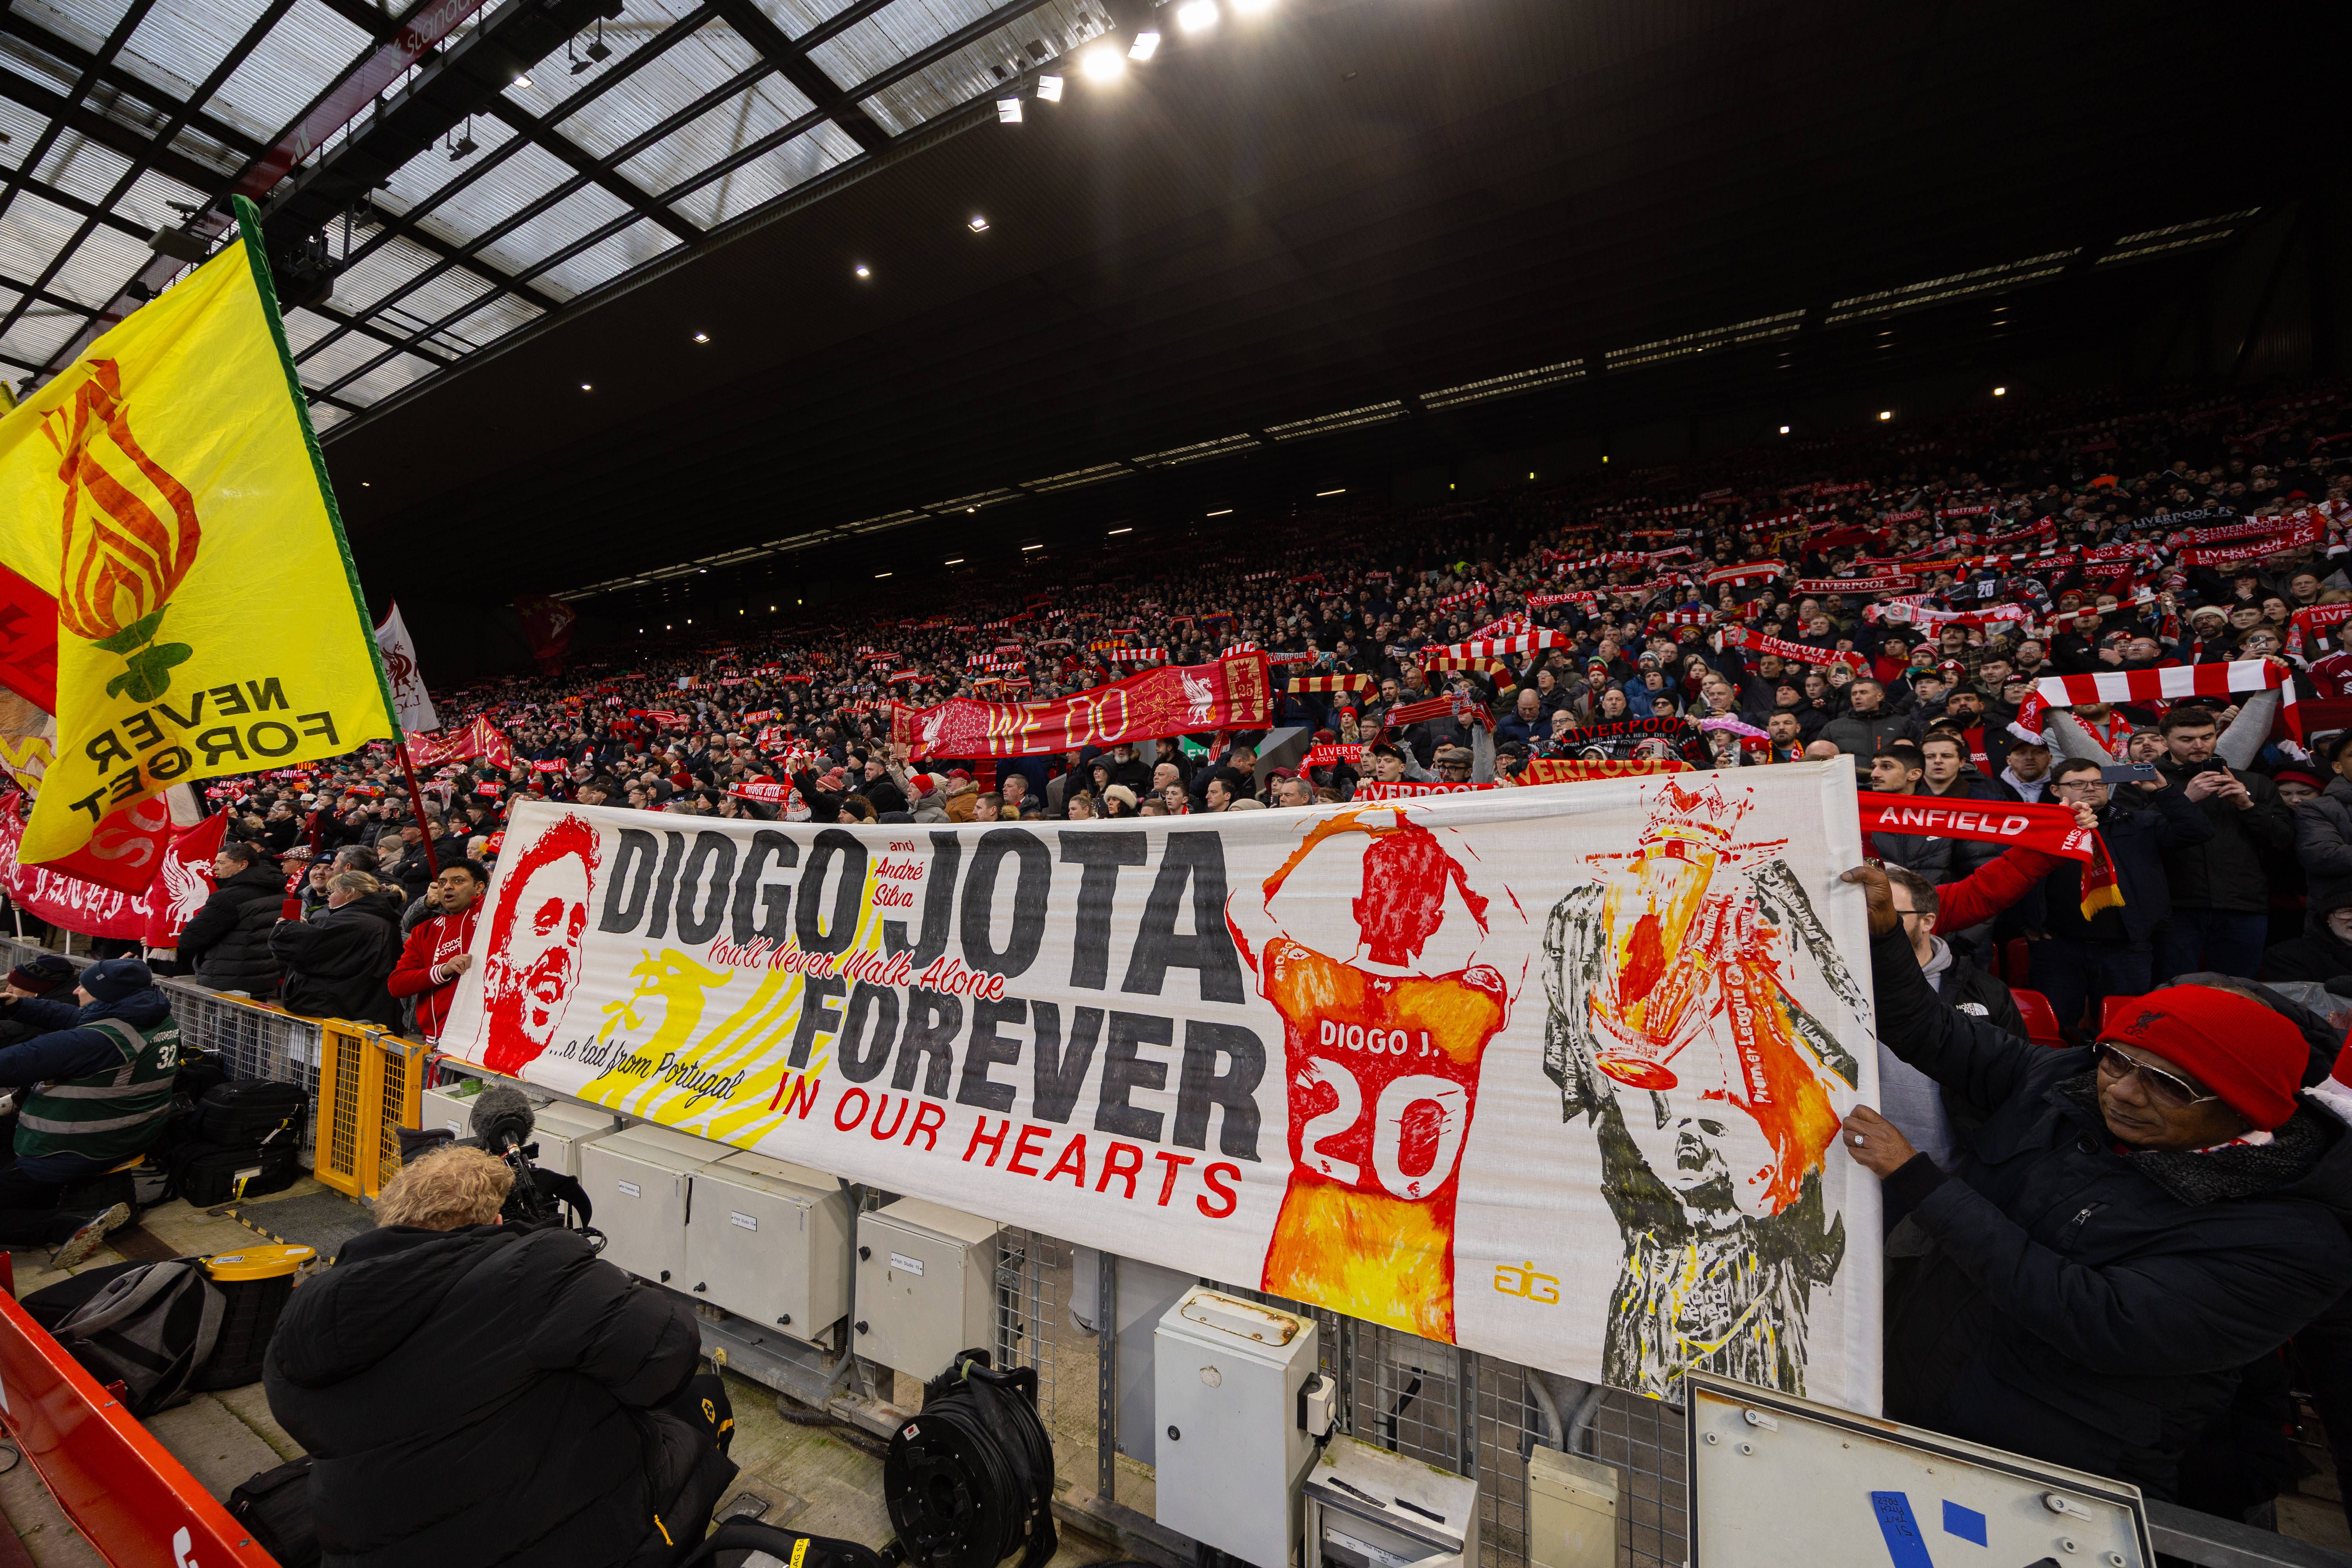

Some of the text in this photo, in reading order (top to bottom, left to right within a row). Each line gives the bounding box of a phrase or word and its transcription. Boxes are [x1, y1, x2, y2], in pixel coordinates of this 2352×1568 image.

[2132, 508, 2211, 528] LIVERPOOL
[2211, 520, 2275, 537] LIVERPOOL
[2196, 526, 2314, 560] LIVERPOOL FC
[2198, 536, 2315, 565] YOU'LL NEVER WALK ALONE
[1811, 580, 1888, 591] LIVERPOOL
[1977, 584, 1994, 599] 20
[1529, 593, 1579, 603] LIVERPOOL
[2307, 603, 2350, 612] HAMPIONS
[1270, 652, 1308, 663] LIVERPOOL
[1760, 645, 1778, 655] YOU'LL
[1782, 650, 1800, 659] NEVER
[1762, 635, 1847, 662] LIVERPOOL FC
[1238, 682, 1255, 697] 25
[747, 710, 768, 723] ARNE SLOT
[987, 688, 1129, 755] WE DO
[1316, 754, 1337, 762] YOU'LL
[1318, 746, 1363, 757] LIVERPO
[1519, 760, 1672, 786] VERPOOL
[745, 785, 765, 795] DIOGO
[764, 786, 781, 797] JOTA
[1352, 784, 1479, 802] LIVERPOO
[1879, 806, 2029, 836] ANFIELD
[890, 840, 915, 852] and
[2061, 828, 2082, 851] THIS
[874, 857, 925, 880] André
[872, 884, 914, 908] Silva
[598, 828, 1246, 1004] DIOGO JOTA
[708, 933, 1005, 1000] You'll Never Walk Alone
[1320, 1020, 1440, 1058] DIOGO J.
[157, 1044, 176, 1069] 32
[787, 972, 1266, 1162] FOREVER
[578, 1035, 609, 1068] lad
[597, 1039, 651, 1080] from
[652, 1052, 745, 1109] Portugal
[1295, 1055, 1470, 1200] 20
[768, 1071, 1243, 1219] IN OUR HEARTS
[1881, 1505, 1904, 1516] PITCH
[792, 1554, 800, 1568] AG
